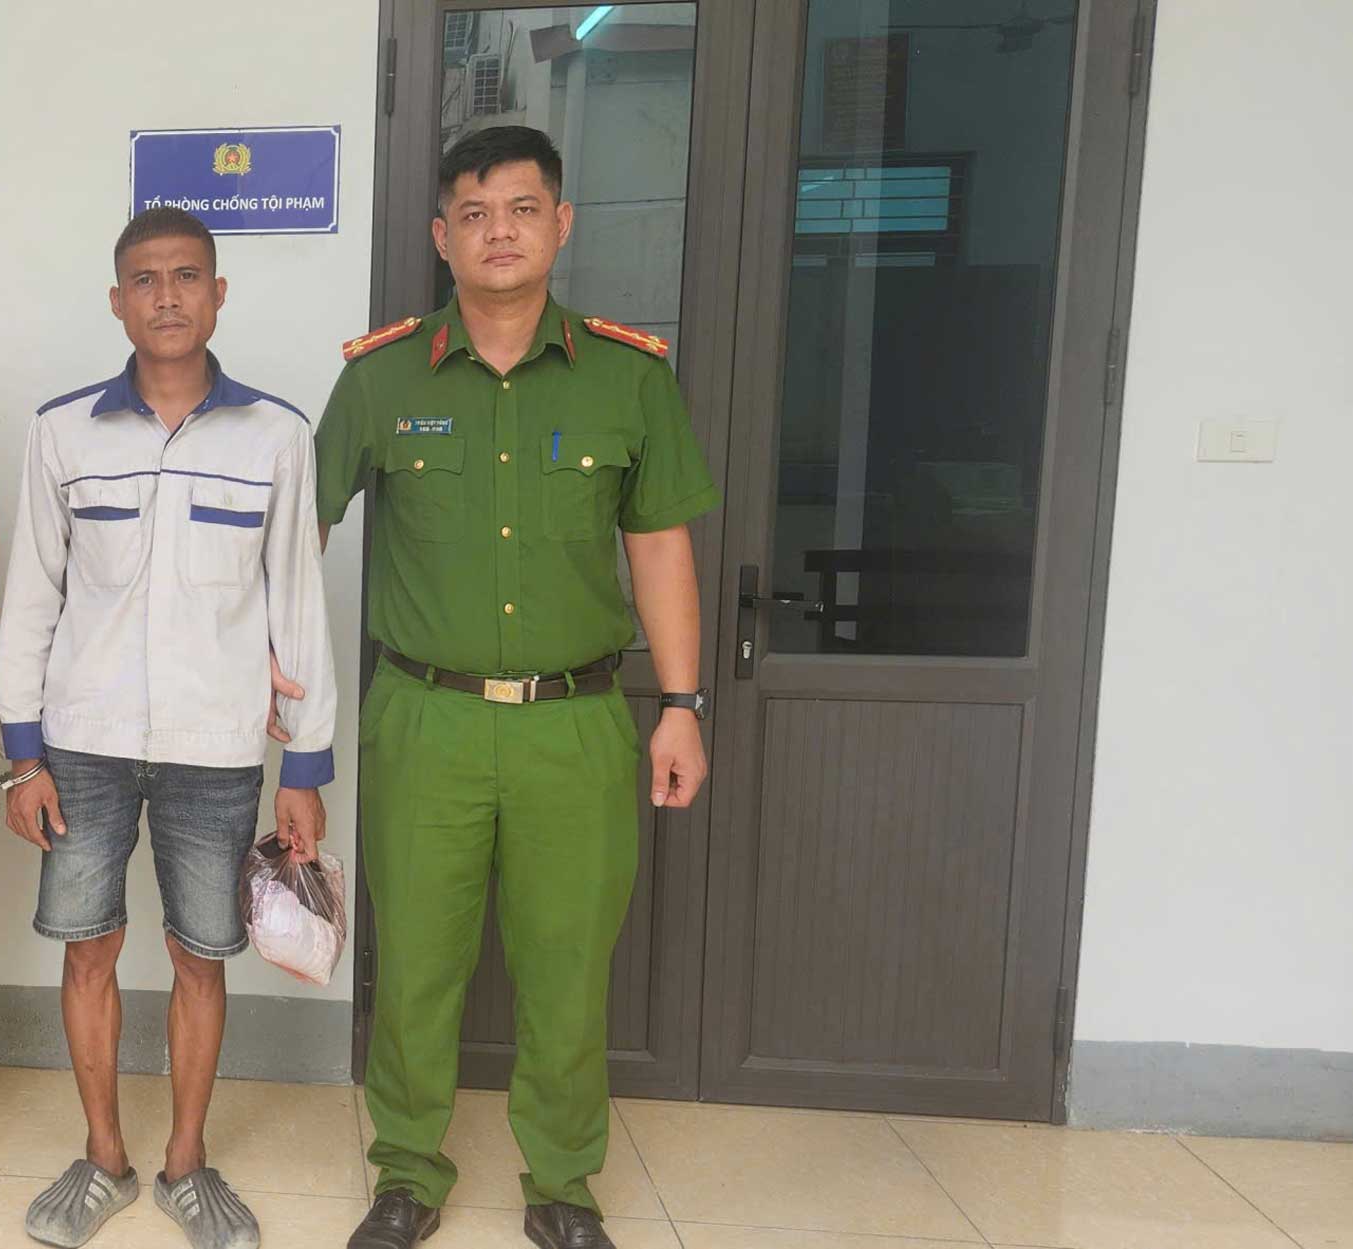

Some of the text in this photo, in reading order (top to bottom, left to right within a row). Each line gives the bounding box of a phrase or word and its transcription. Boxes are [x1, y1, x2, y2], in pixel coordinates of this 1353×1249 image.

[164, 196, 210, 211] PHÒNG
[213, 194, 259, 211] CHỐNG
[261, 195, 283, 212] TỘI
[286, 196, 325, 212] PHẠM
